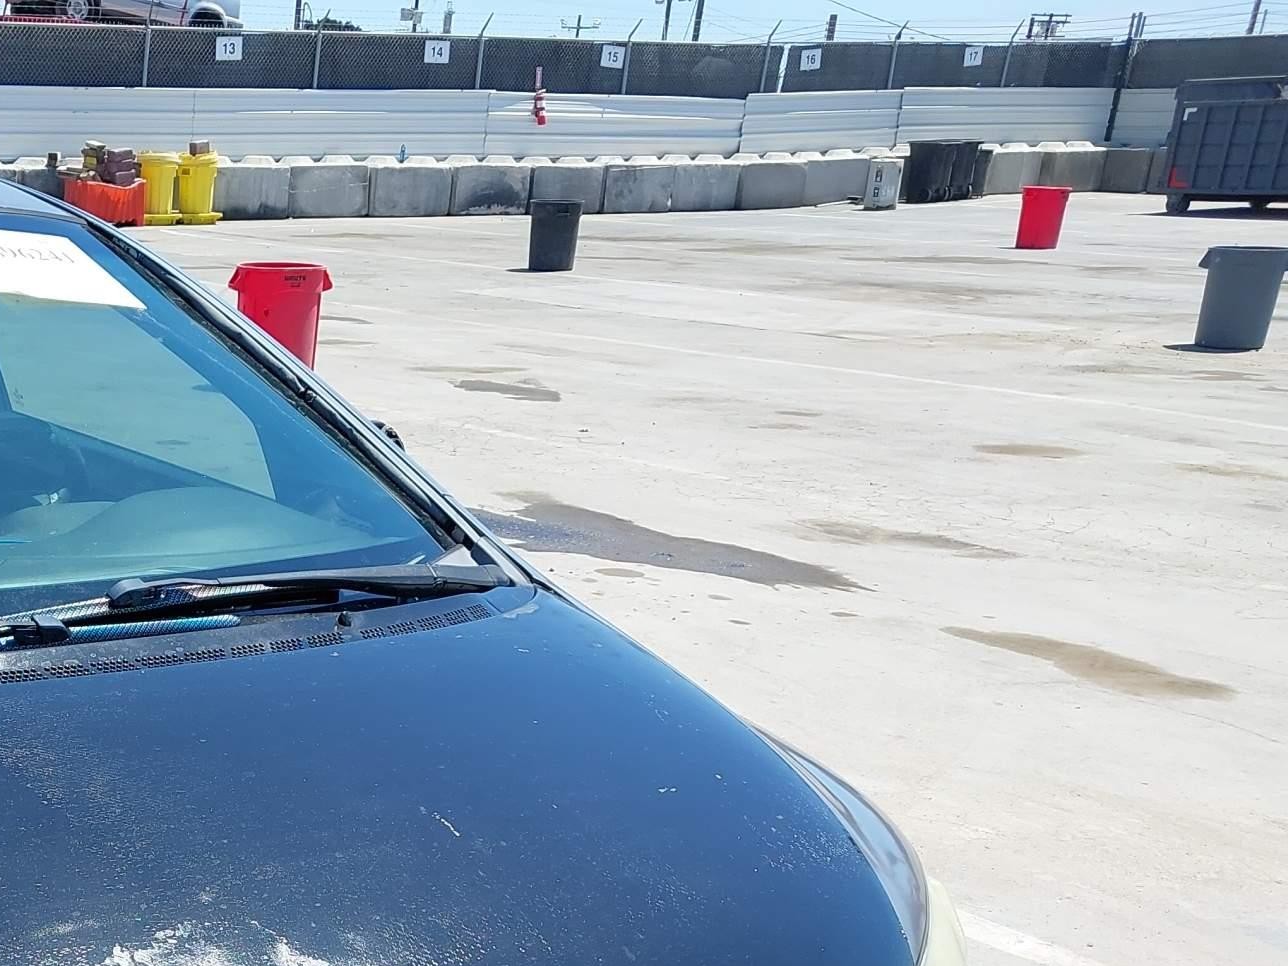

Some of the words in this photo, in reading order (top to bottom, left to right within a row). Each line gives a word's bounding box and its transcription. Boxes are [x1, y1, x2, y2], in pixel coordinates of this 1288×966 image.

[223, 42, 236, 55] 13
[431, 46, 443, 58] 14
[607, 51, 619, 63] 15
[806, 54, 816, 65] 16
[969, 51, 978, 62] 17
